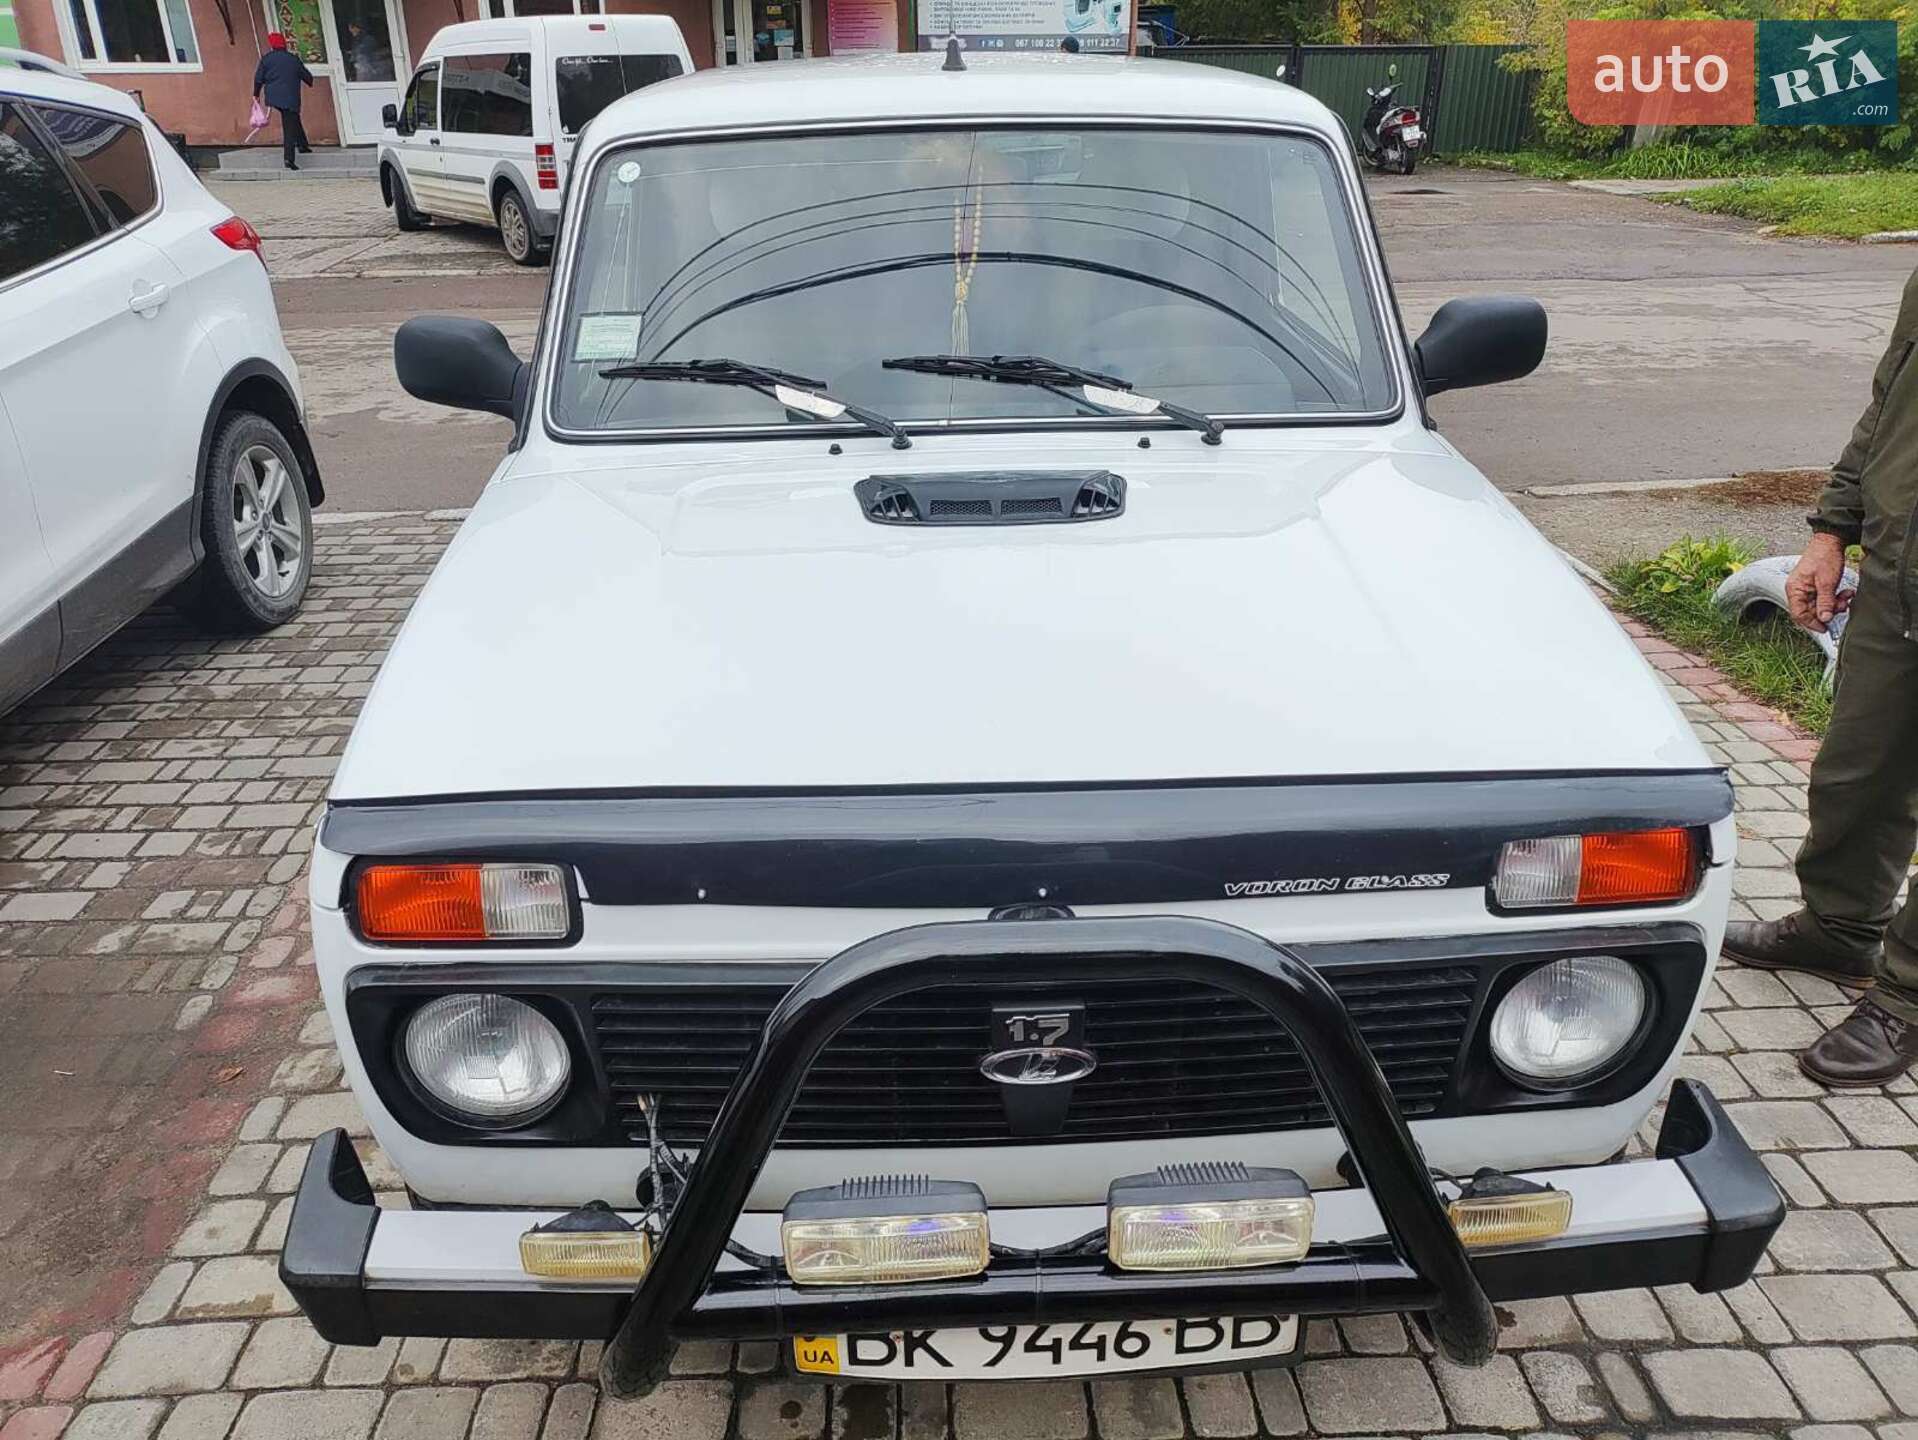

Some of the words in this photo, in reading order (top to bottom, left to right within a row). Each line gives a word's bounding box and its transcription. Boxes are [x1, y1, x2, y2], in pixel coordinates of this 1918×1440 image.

[1224, 877, 1341, 897] VORON
[1344, 873, 1450, 890] GLASS
[1005, 1013, 1071, 1047] 1.7
[804, 1350, 834, 1364] UA
[979, 1321, 1151, 1368] 9446
